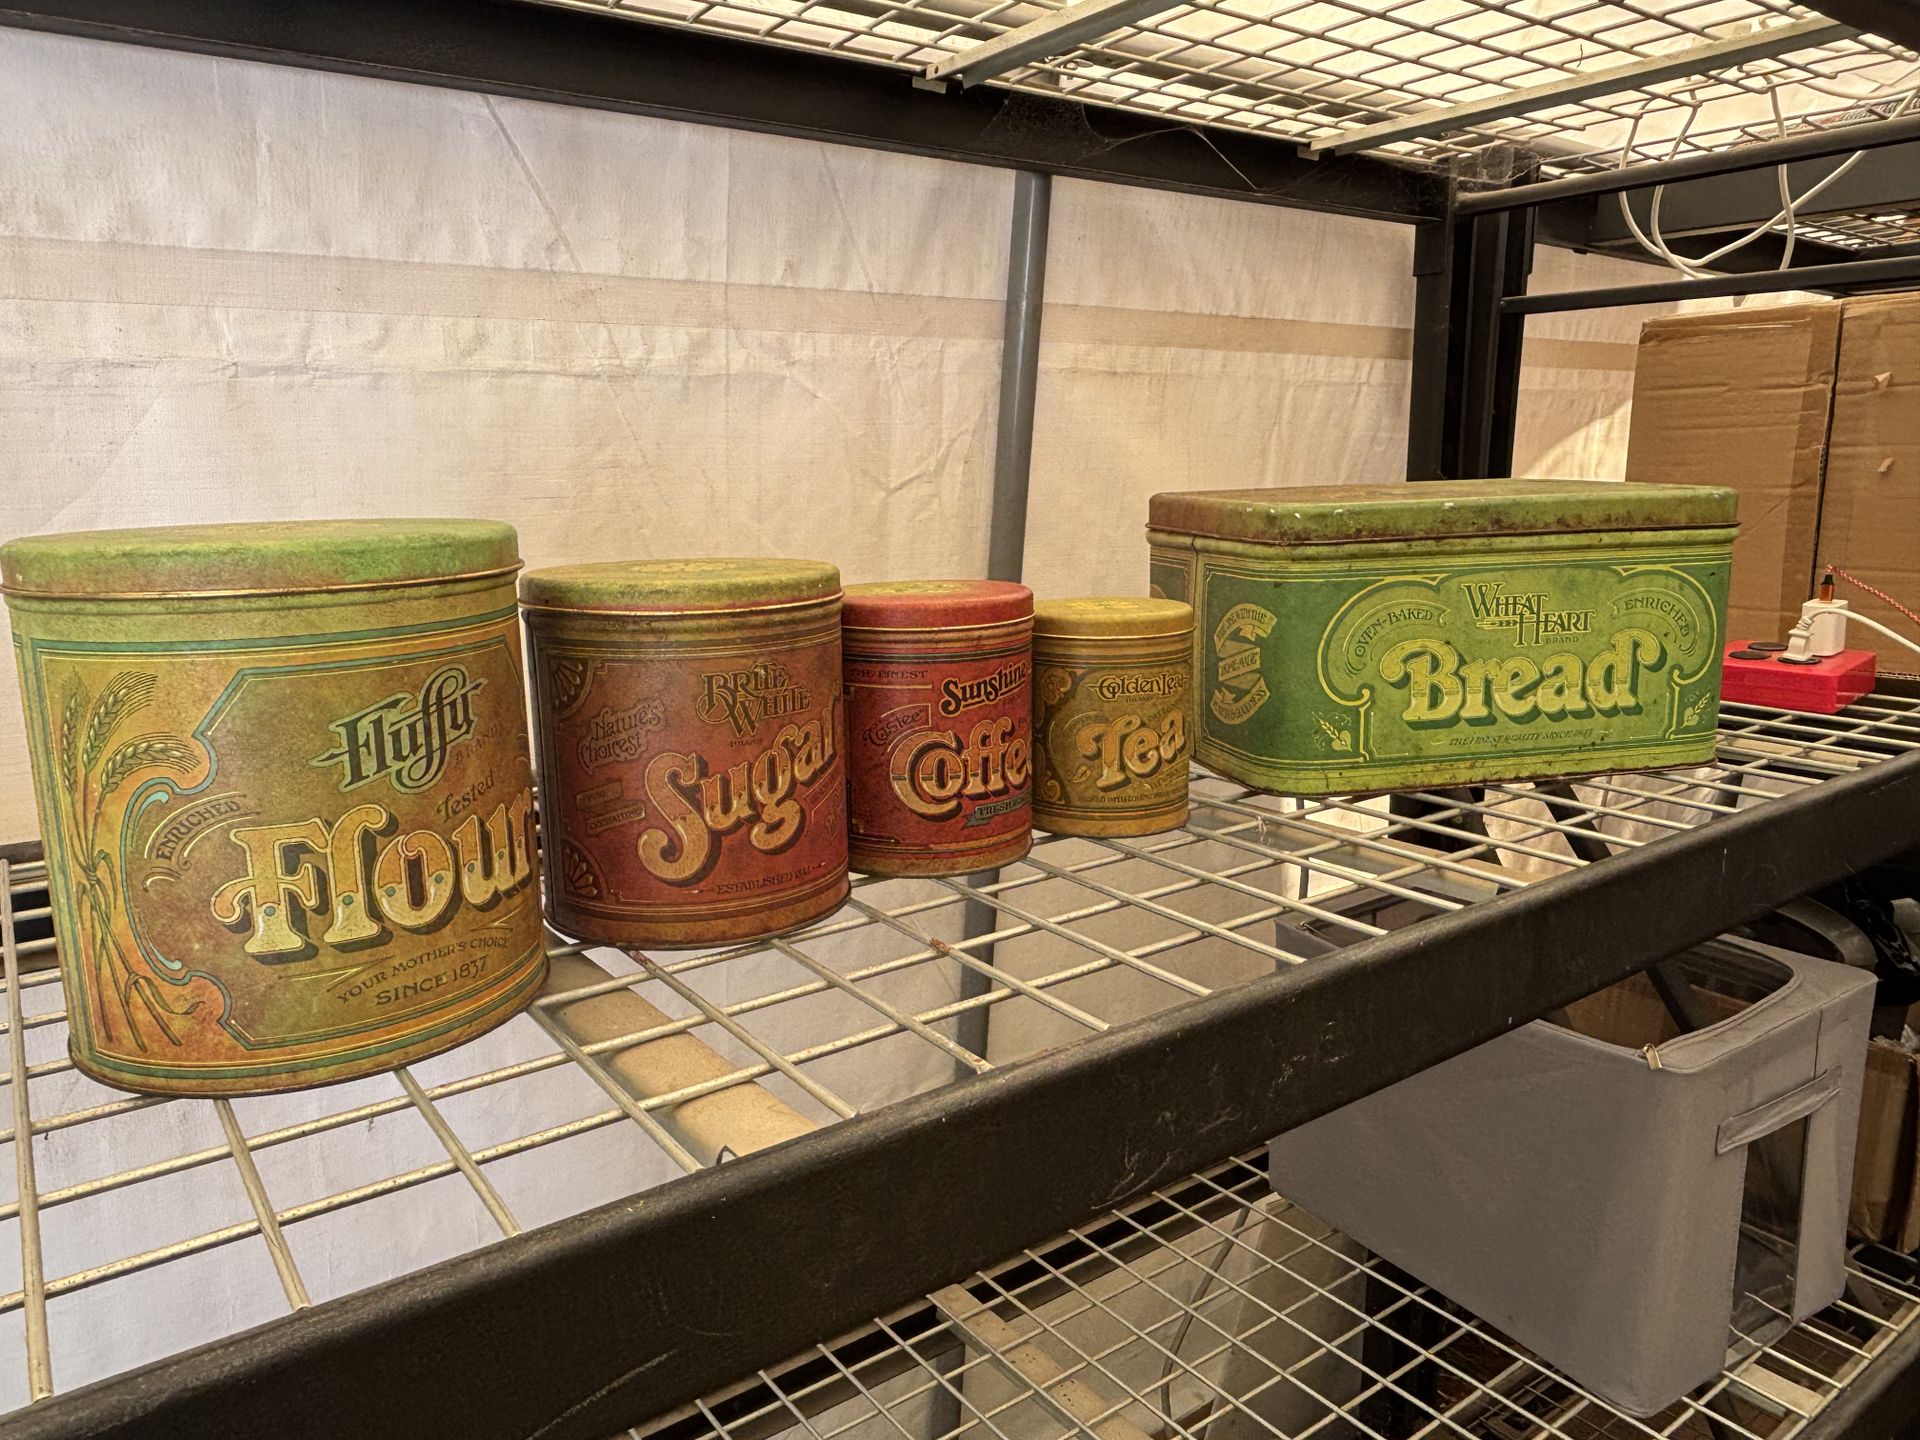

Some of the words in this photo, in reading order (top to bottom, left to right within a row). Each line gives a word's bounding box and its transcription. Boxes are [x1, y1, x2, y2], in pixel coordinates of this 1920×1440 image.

[1462, 582, 1549, 619] WHEAT
[1624, 596, 1691, 637] ENRICHED
[1354, 607, 1434, 658] OVEN-BAKED
[1513, 609, 1596, 646] HEART
[1544, 635, 1580, 645] BRAND
[877, 669, 928, 680] FINEST
[939, 660, 1028, 717] Sunshine
[1379, 628, 1663, 729] Bread
[312, 664, 487, 792] Fluffy
[454, 724, 499, 768] BRAND
[591, 702, 662, 742] Nature's
[1076, 708, 1186, 792] Tea
[436, 769, 495, 823] Tested
[637, 682, 841, 884] Sugar
[156, 799, 241, 861] ENRICHED
[210, 786, 533, 957] Flour
[336, 970, 388, 1004] YOUR
[391, 939, 467, 977] MOTHER'S
[375, 972, 449, 1006] SINCE
